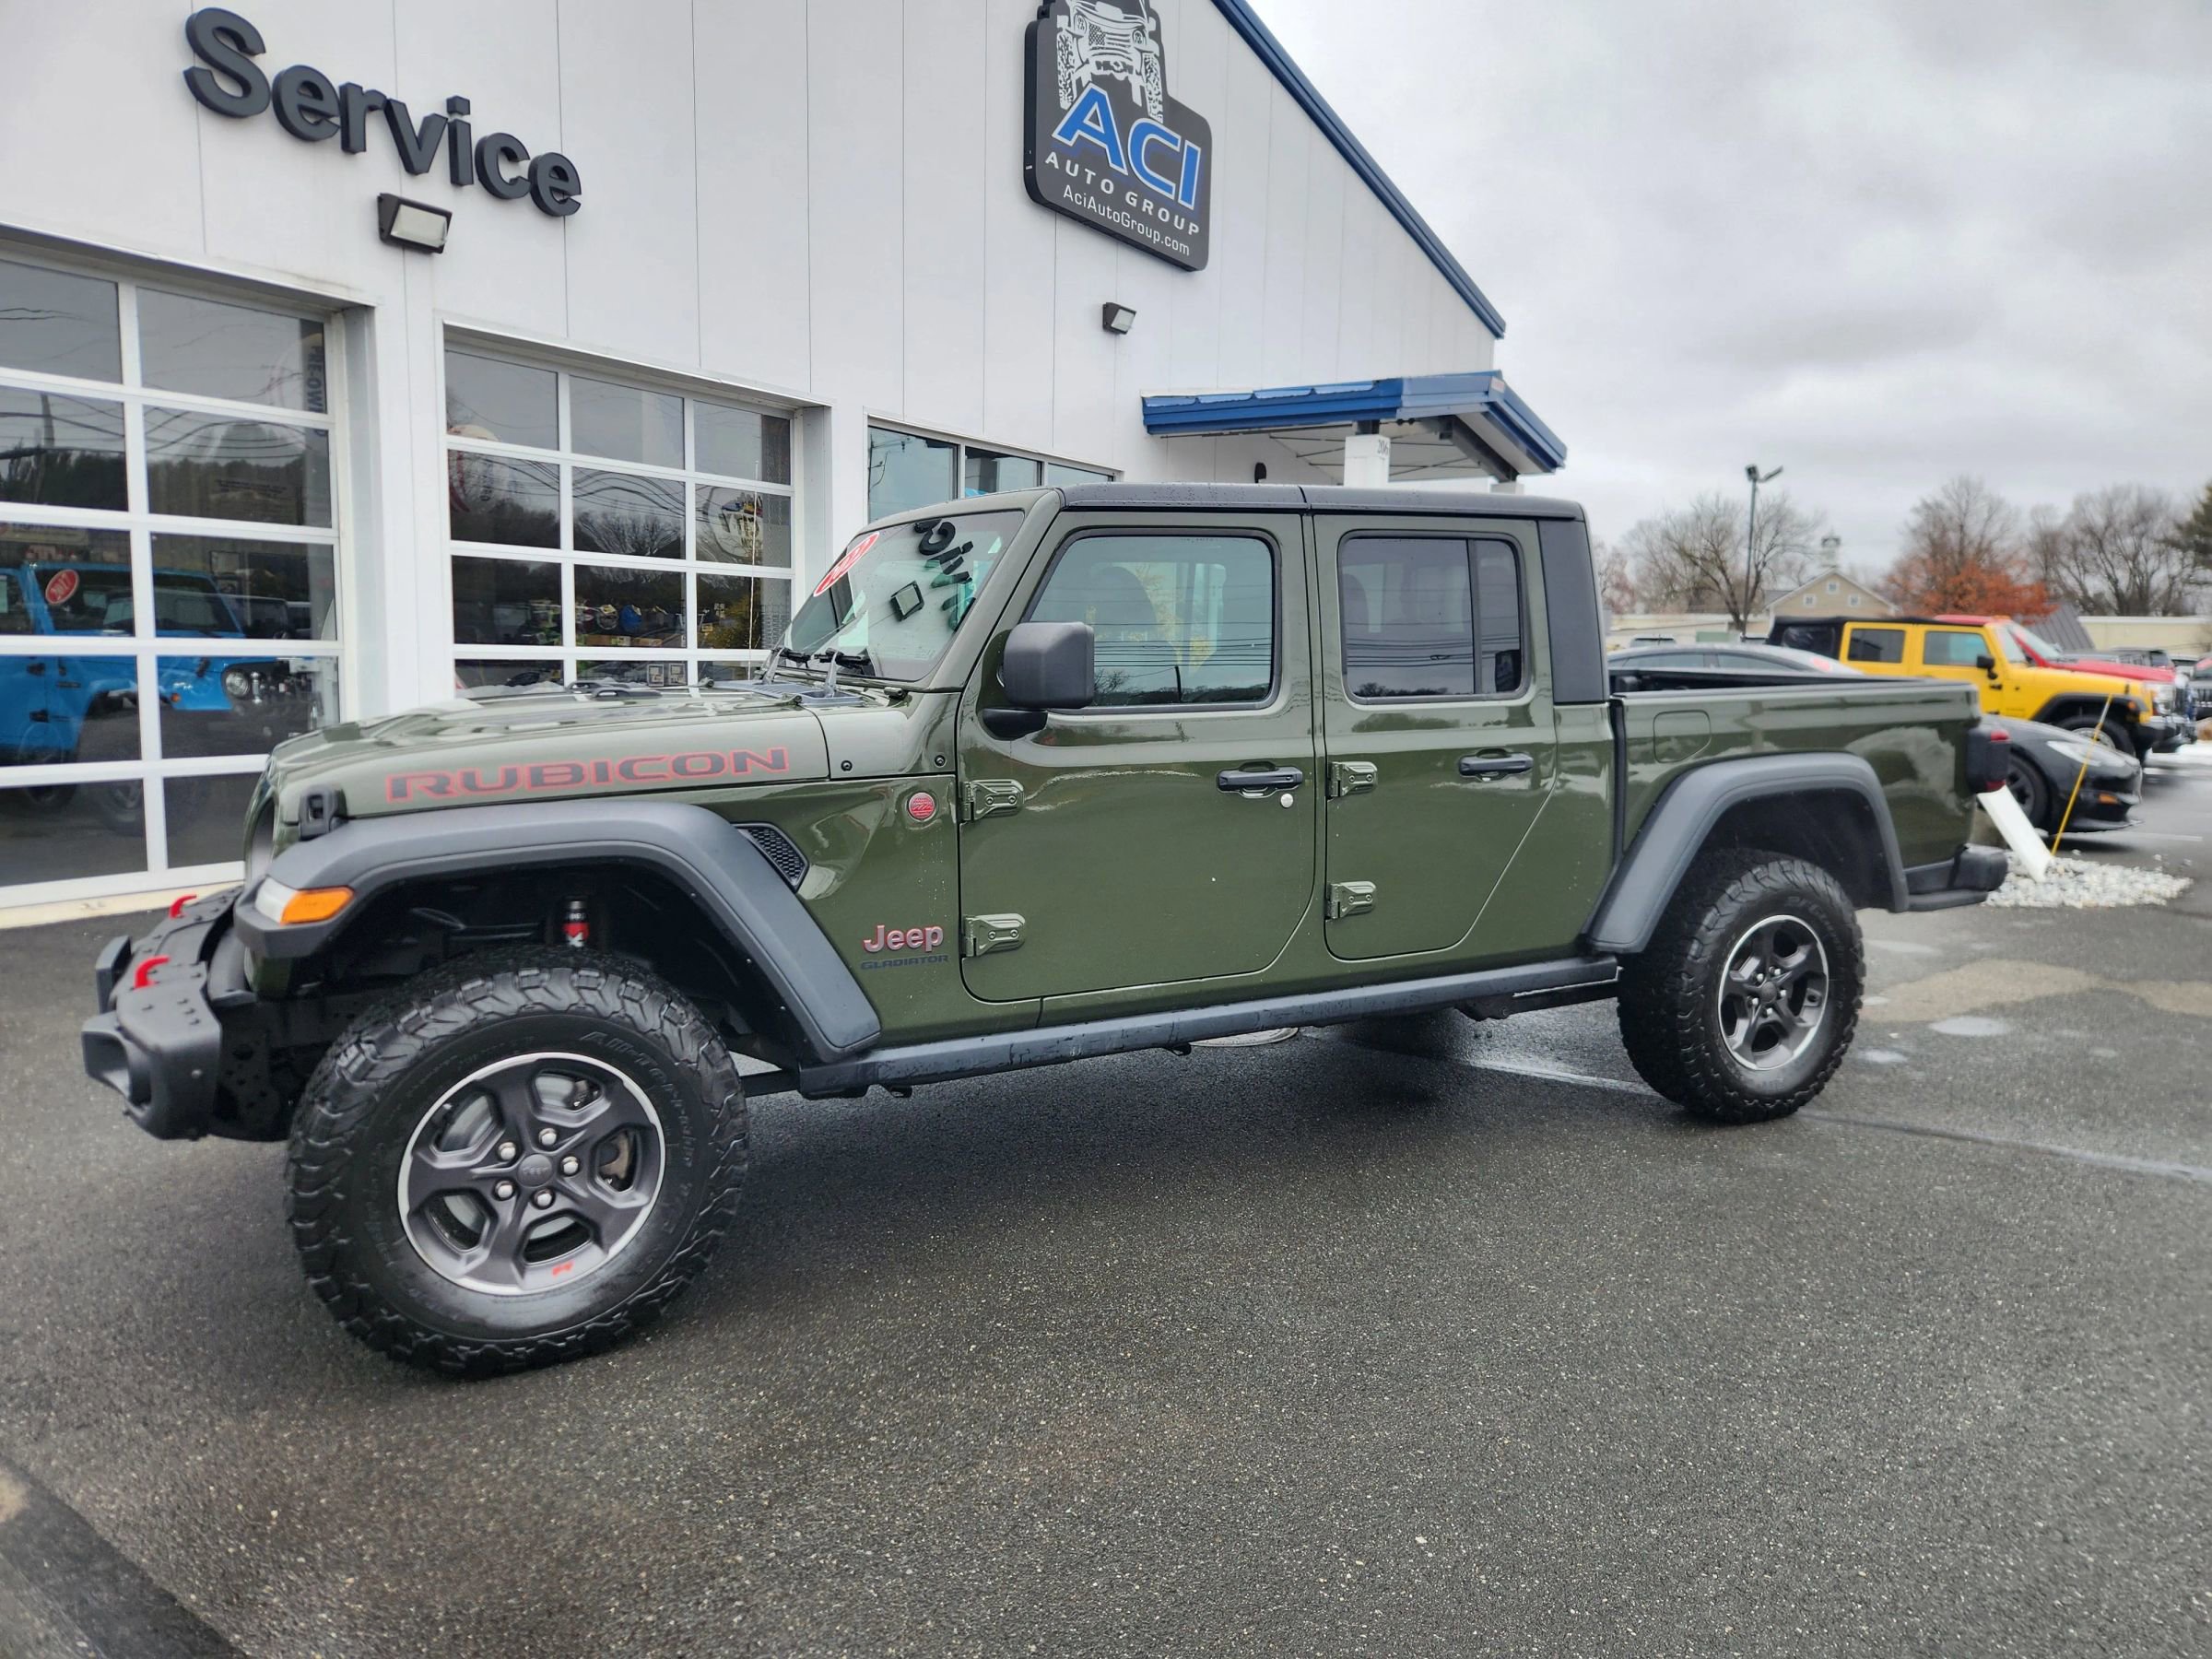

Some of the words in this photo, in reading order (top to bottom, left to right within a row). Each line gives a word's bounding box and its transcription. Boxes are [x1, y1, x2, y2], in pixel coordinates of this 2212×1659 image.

[183, 7, 582, 218] Service
[1052, 81, 1201, 210] ACI
[1045, 151, 1114, 194] AUTO
[1124, 191, 1200, 235] GROUP
[1063, 184, 1190, 256] AciAutoGroup.com
[385, 747, 790, 805] RUBICON
[861, 954, 949, 971] GLADIATOR
[863, 924, 944, 953] Jeep
